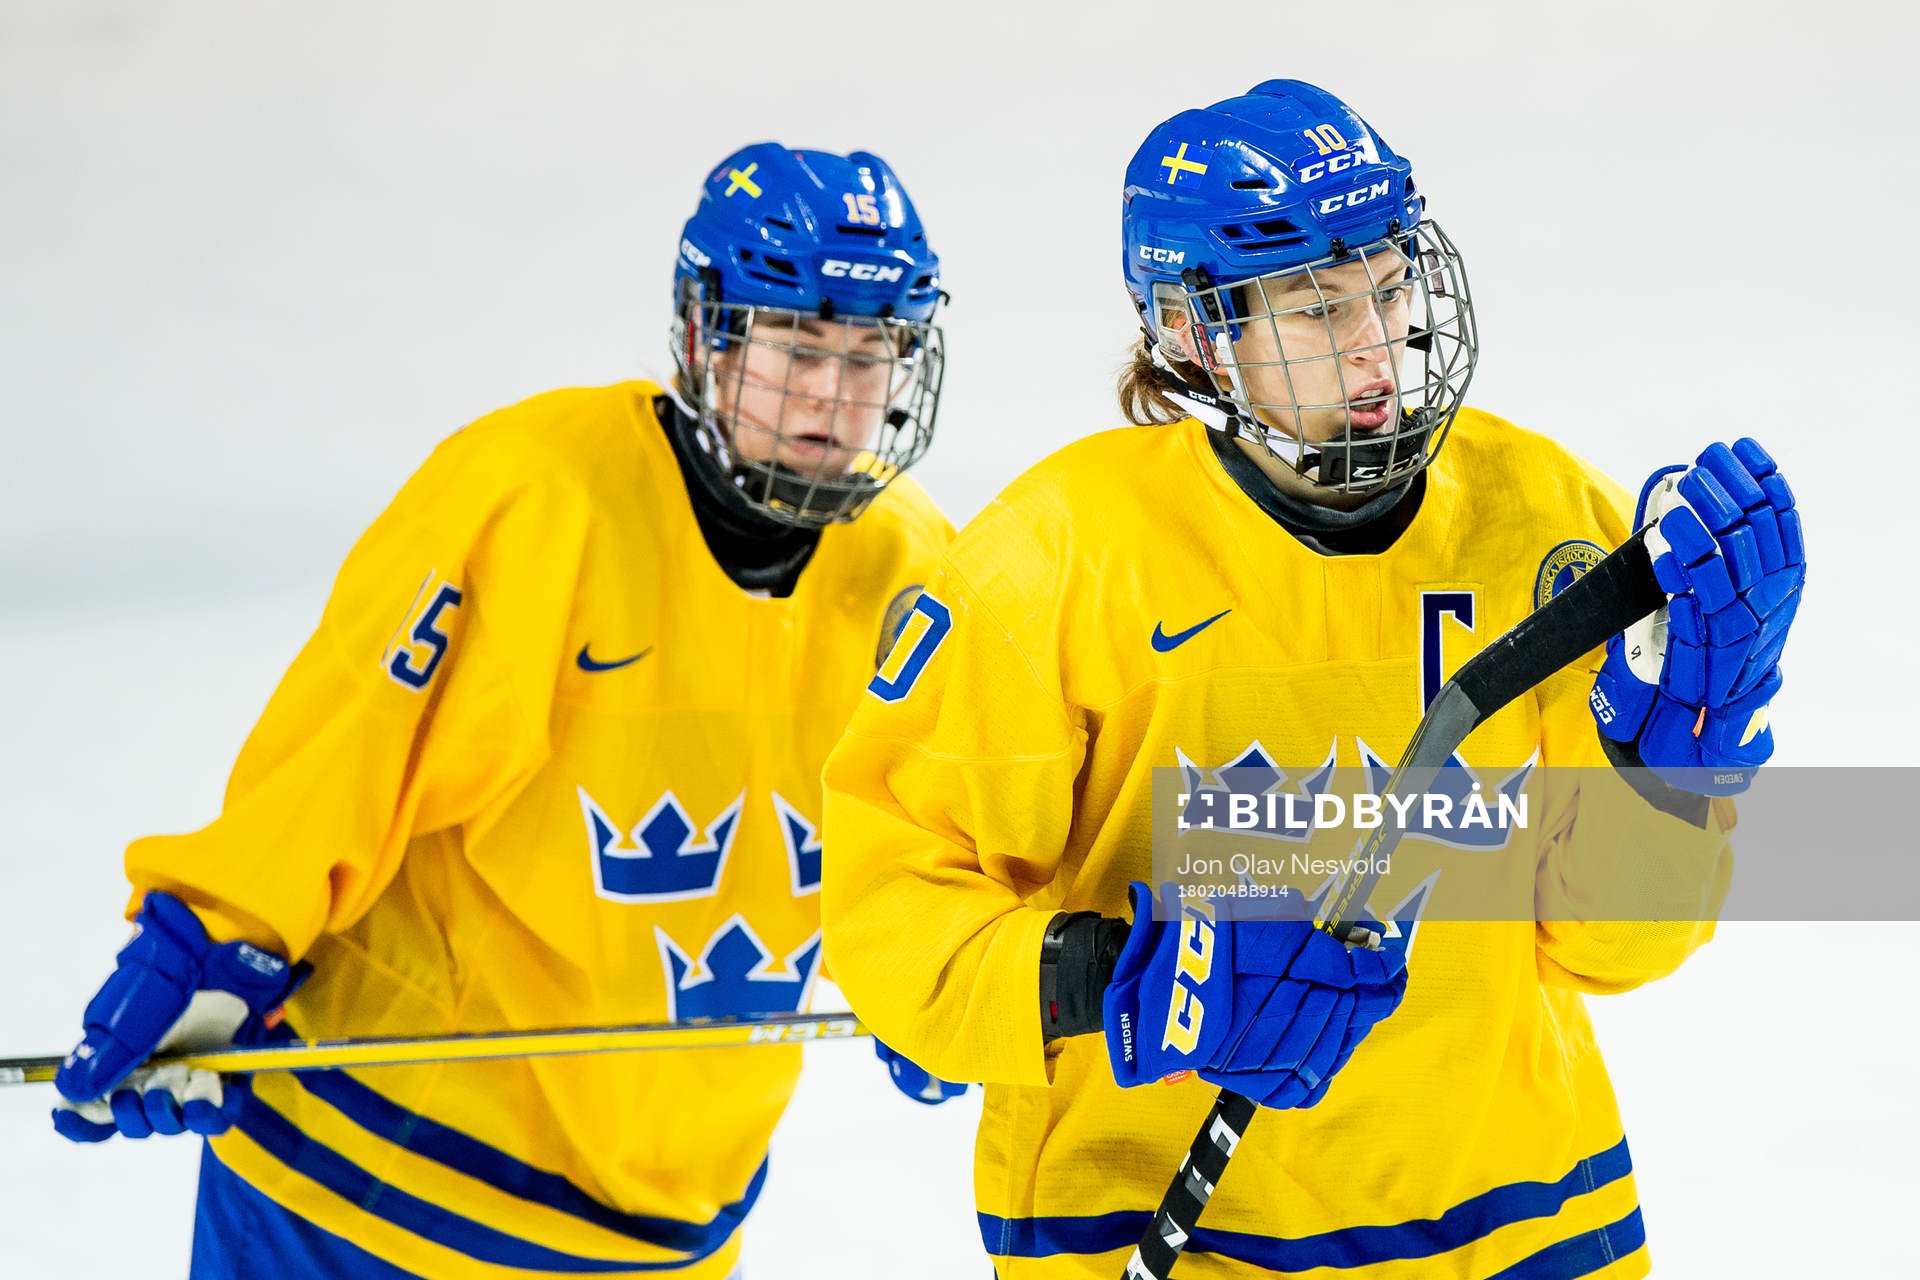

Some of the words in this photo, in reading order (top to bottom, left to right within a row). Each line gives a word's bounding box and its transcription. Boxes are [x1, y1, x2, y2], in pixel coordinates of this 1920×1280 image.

[1303, 124, 1347, 156] 10
[843, 192, 880, 226] 15
[1320, 179, 1390, 214] CCM
[820, 258, 904, 283] CCM
[1140, 244, 1185, 265] CCM
[1188, 390, 1217, 405] CCM
[1556, 550, 1601, 569] ISHOCKE
[380, 567, 463, 693] 5
[867, 591, 953, 704] 0
[1714, 773, 1744, 785] SWEDEN
[1120, 1013, 1133, 1062] SWEDEN
